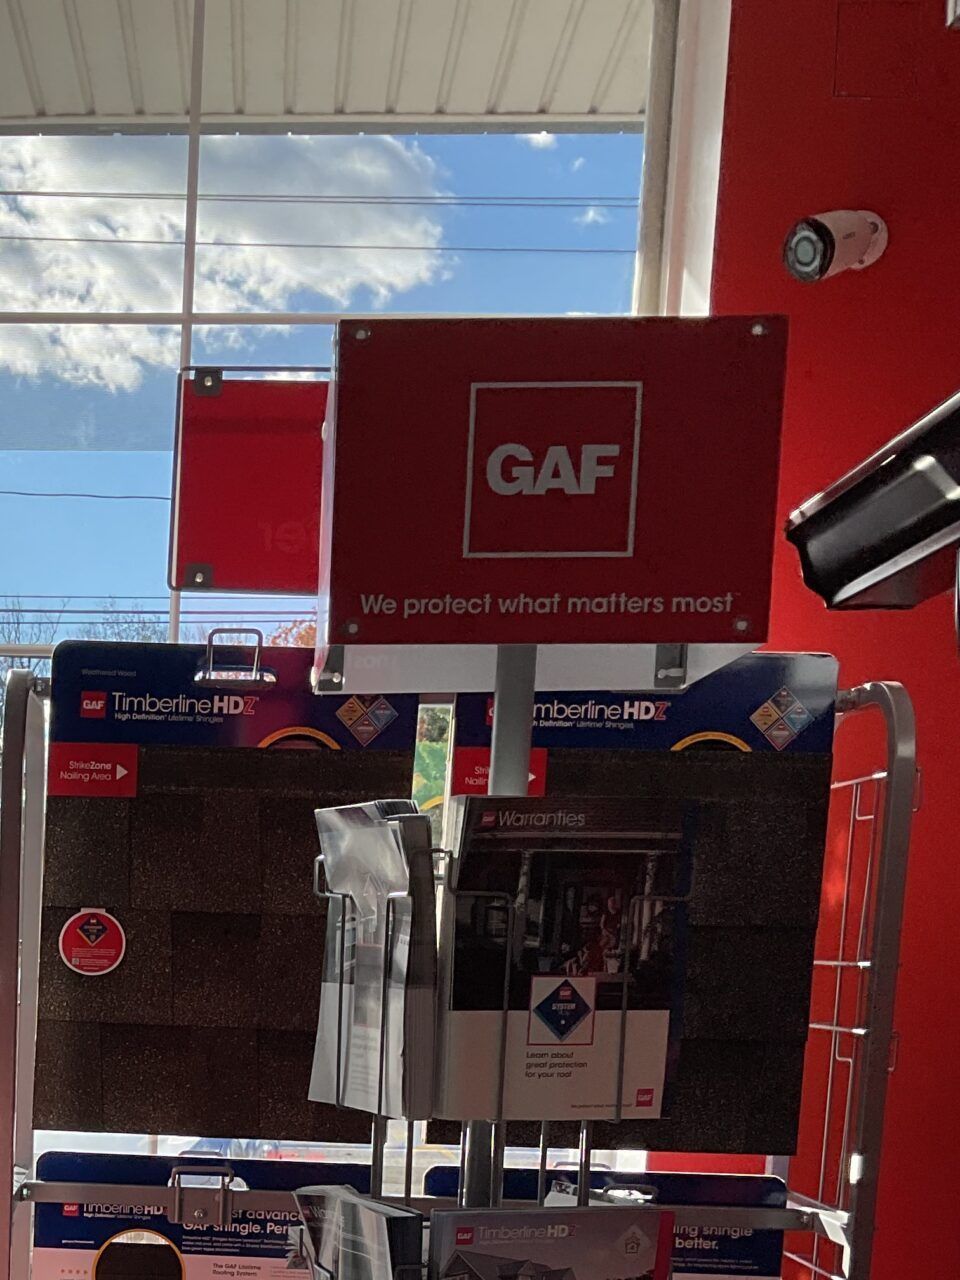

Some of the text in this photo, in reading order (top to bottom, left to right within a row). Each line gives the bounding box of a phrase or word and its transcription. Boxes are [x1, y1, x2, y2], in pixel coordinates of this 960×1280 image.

[487, 443, 620, 495] GAF
[360, 594, 397, 614] We
[403, 594, 492, 618] protect
[497, 594, 561, 614] what
[567, 592, 664, 613] matters
[83, 700, 105, 710] GAF
[112, 692, 211, 713] Timberline
[533, 700, 621, 719] mberline
[60, 771, 112, 782] Nailing Area
[499, 810, 585, 827] Warranties
[526, 1062, 588, 1070] great protection
[457, 1232, 473, 1240] GAF
[479, 1226, 546, 1240] Timberline
[675, 1236, 720, 1250] better.
